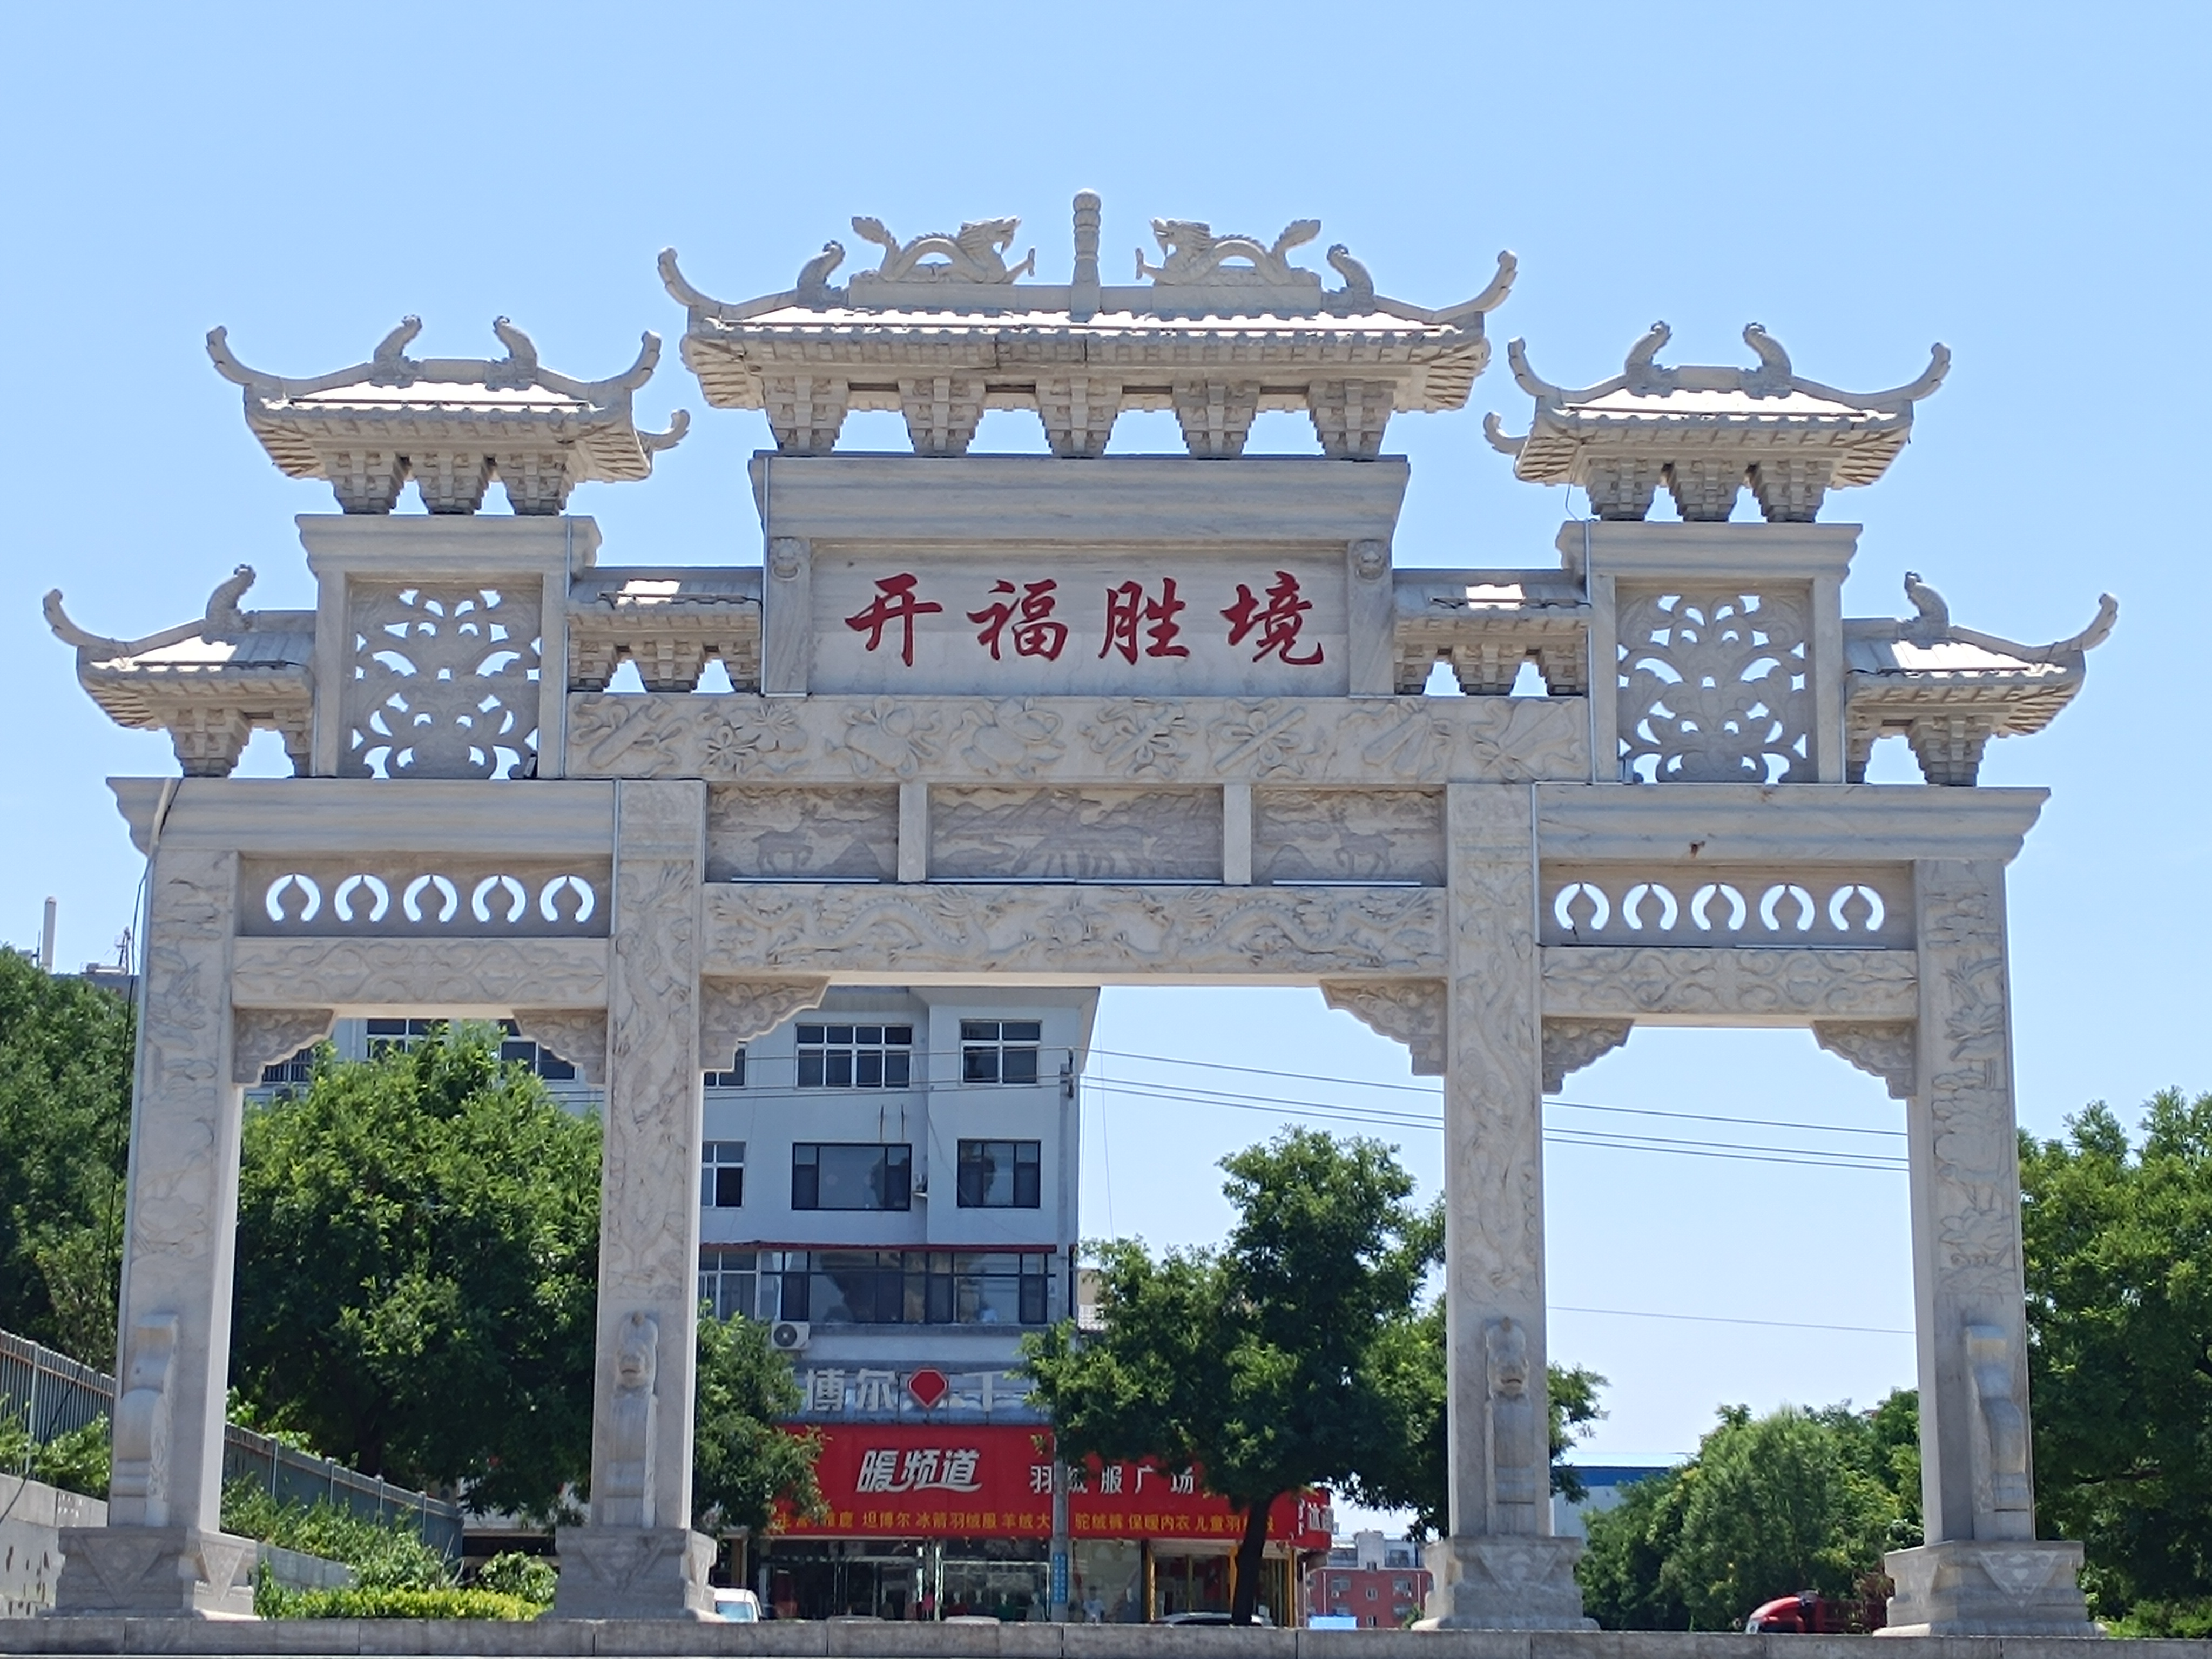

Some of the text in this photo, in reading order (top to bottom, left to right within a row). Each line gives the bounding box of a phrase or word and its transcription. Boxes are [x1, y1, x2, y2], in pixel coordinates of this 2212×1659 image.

[845, 571, 1324, 666] 开福胜境
[856, 1449, 982, 1493] 暖频道
[1002, 1513, 1052, 1529] 羊绒大
